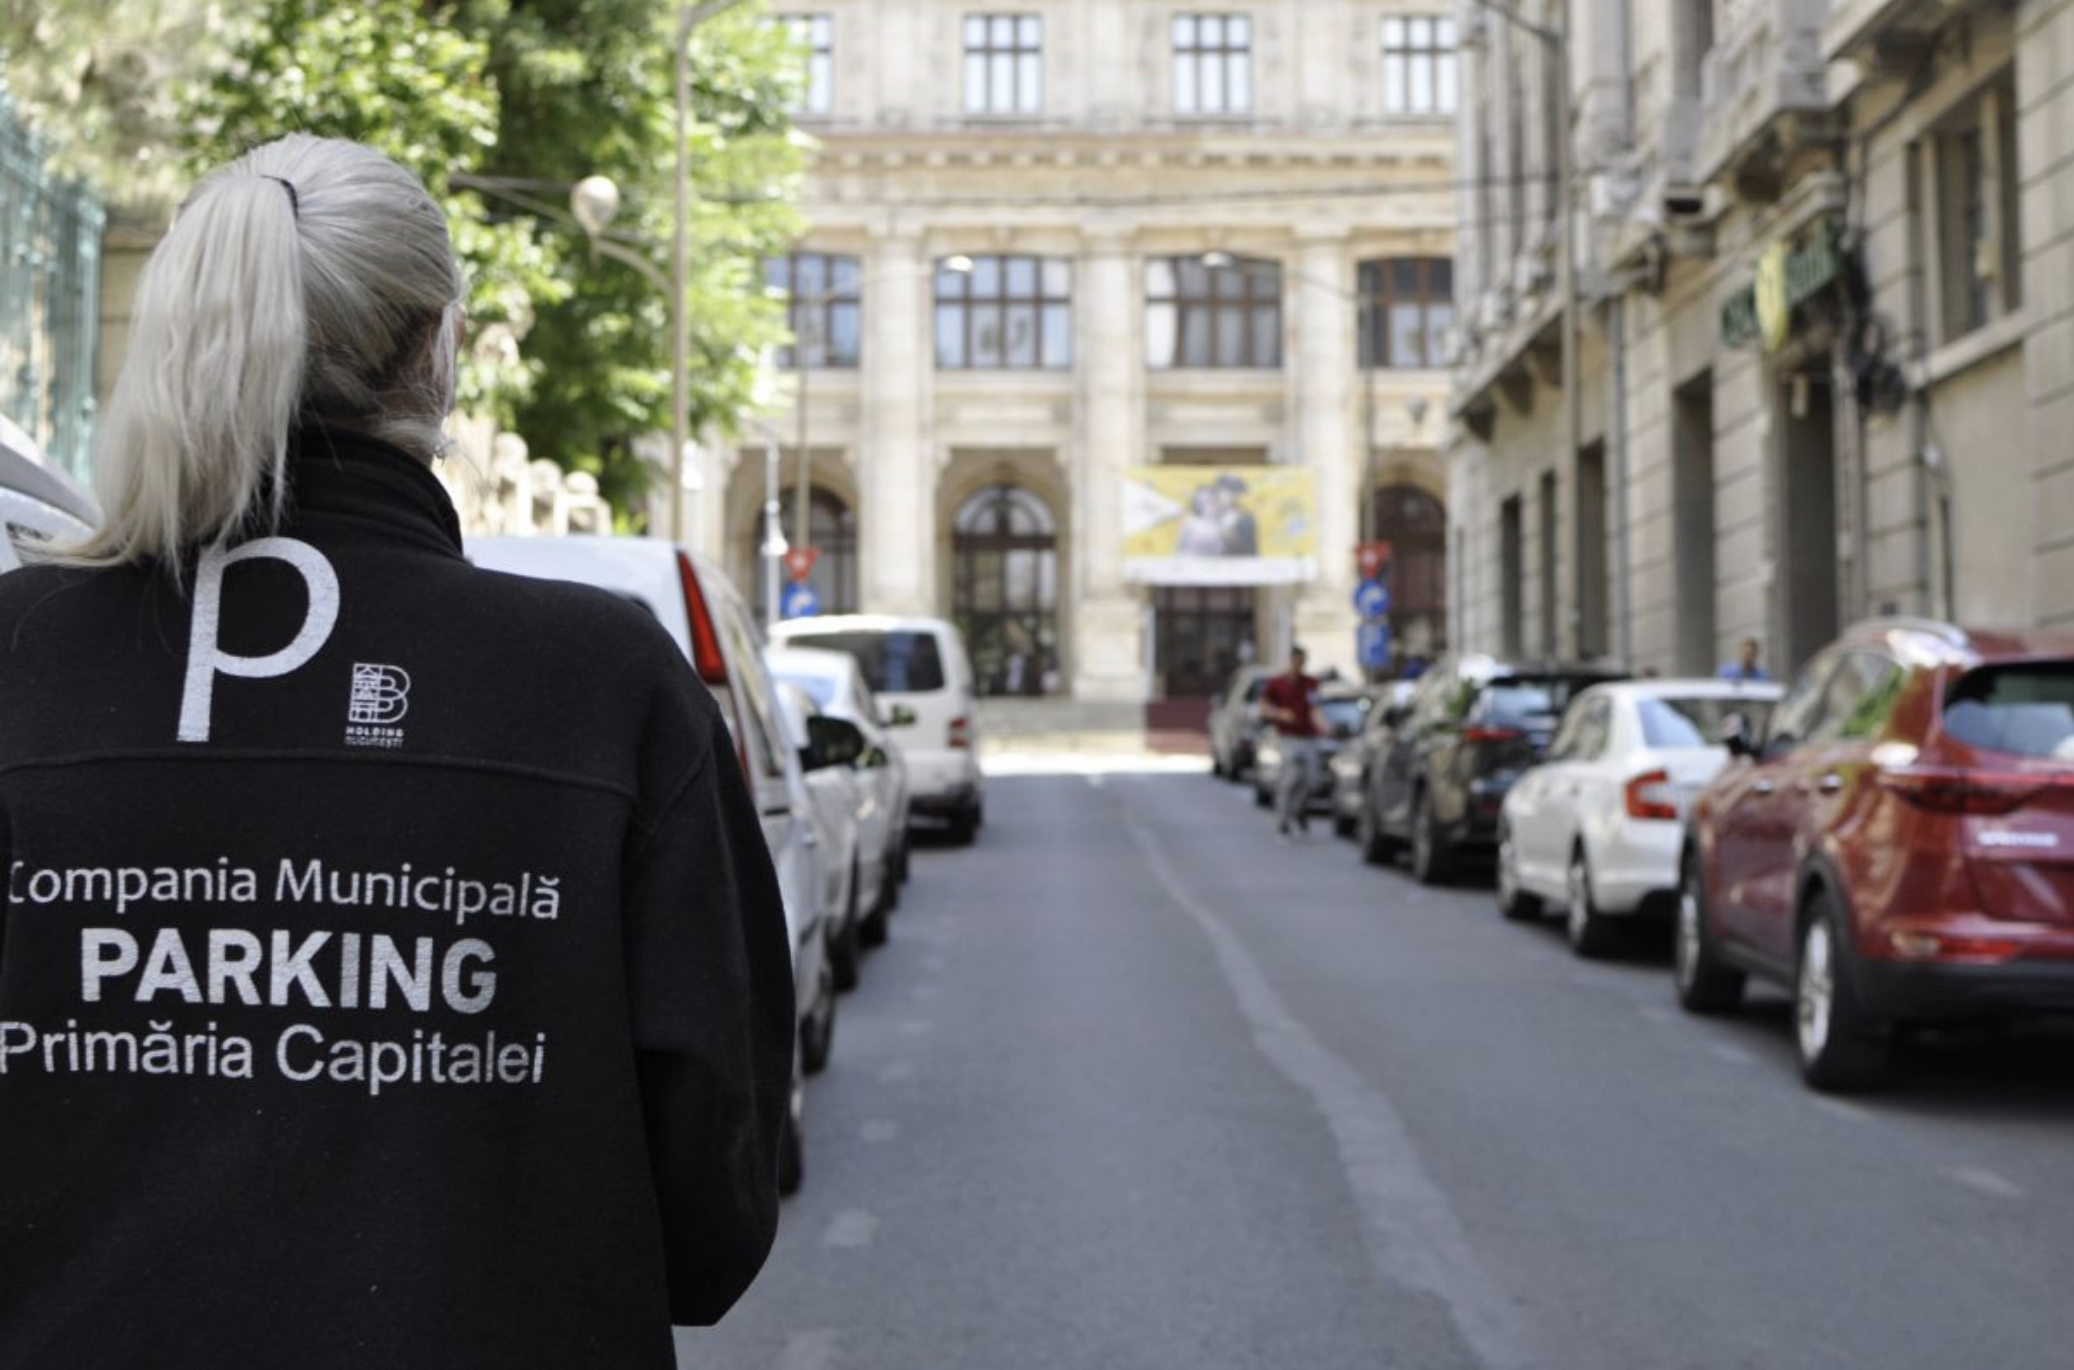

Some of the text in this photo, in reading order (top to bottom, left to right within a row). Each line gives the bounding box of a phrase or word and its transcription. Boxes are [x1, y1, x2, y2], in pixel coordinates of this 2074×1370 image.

[345, 726, 404, 737] HOLDING
[9, 857, 560, 925] Compania Municipală
[81, 927, 497, 1014] PARKING
[0, 1019, 546, 1096] Primăria Capitalei
